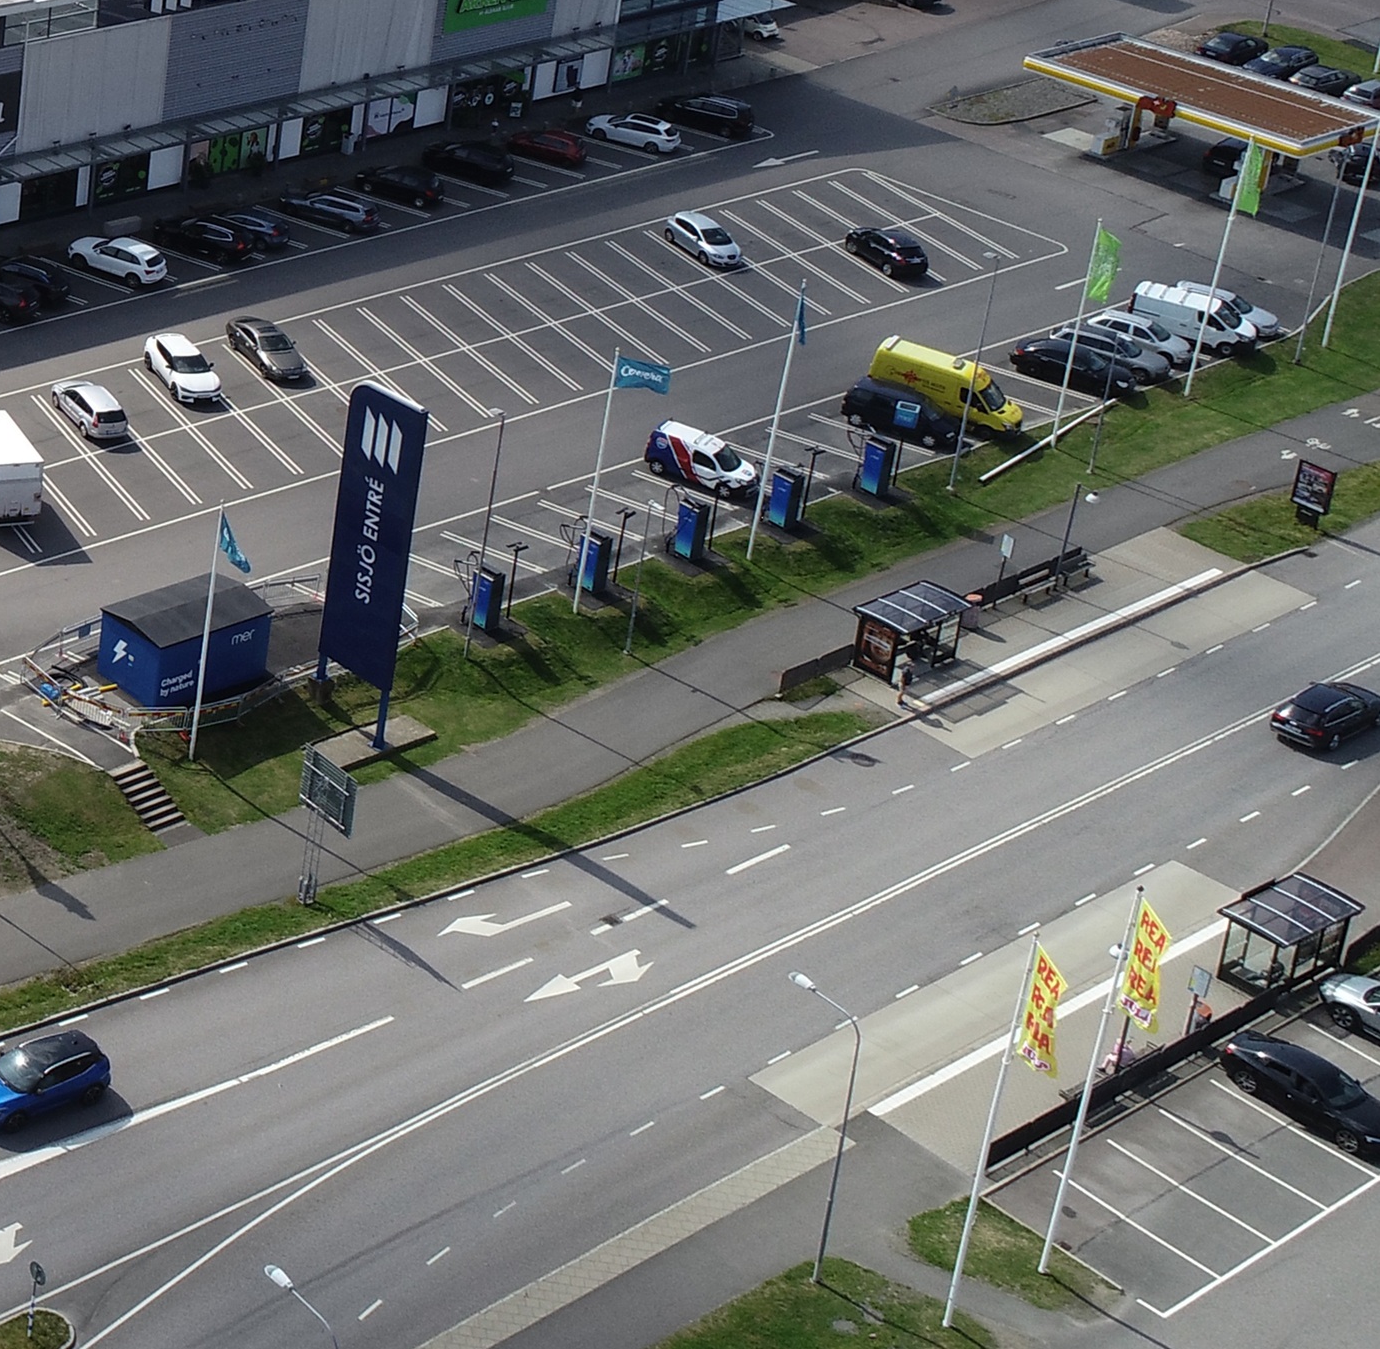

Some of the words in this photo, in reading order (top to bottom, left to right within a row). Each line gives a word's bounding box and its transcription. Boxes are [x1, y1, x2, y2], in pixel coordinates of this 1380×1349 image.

[363, 476, 384, 541] ENTRÉ
[355, 545, 376, 604] SISJÖ
[231, 629, 255, 645] mer
[160, 688, 169, 697] by
[170, 680, 195, 693] nature
[161, 669, 193, 687] Charged
[1141, 910, 1167, 954] REA
[1037, 955, 1061, 1001] REA
[1129, 966, 1156, 1006] REA
